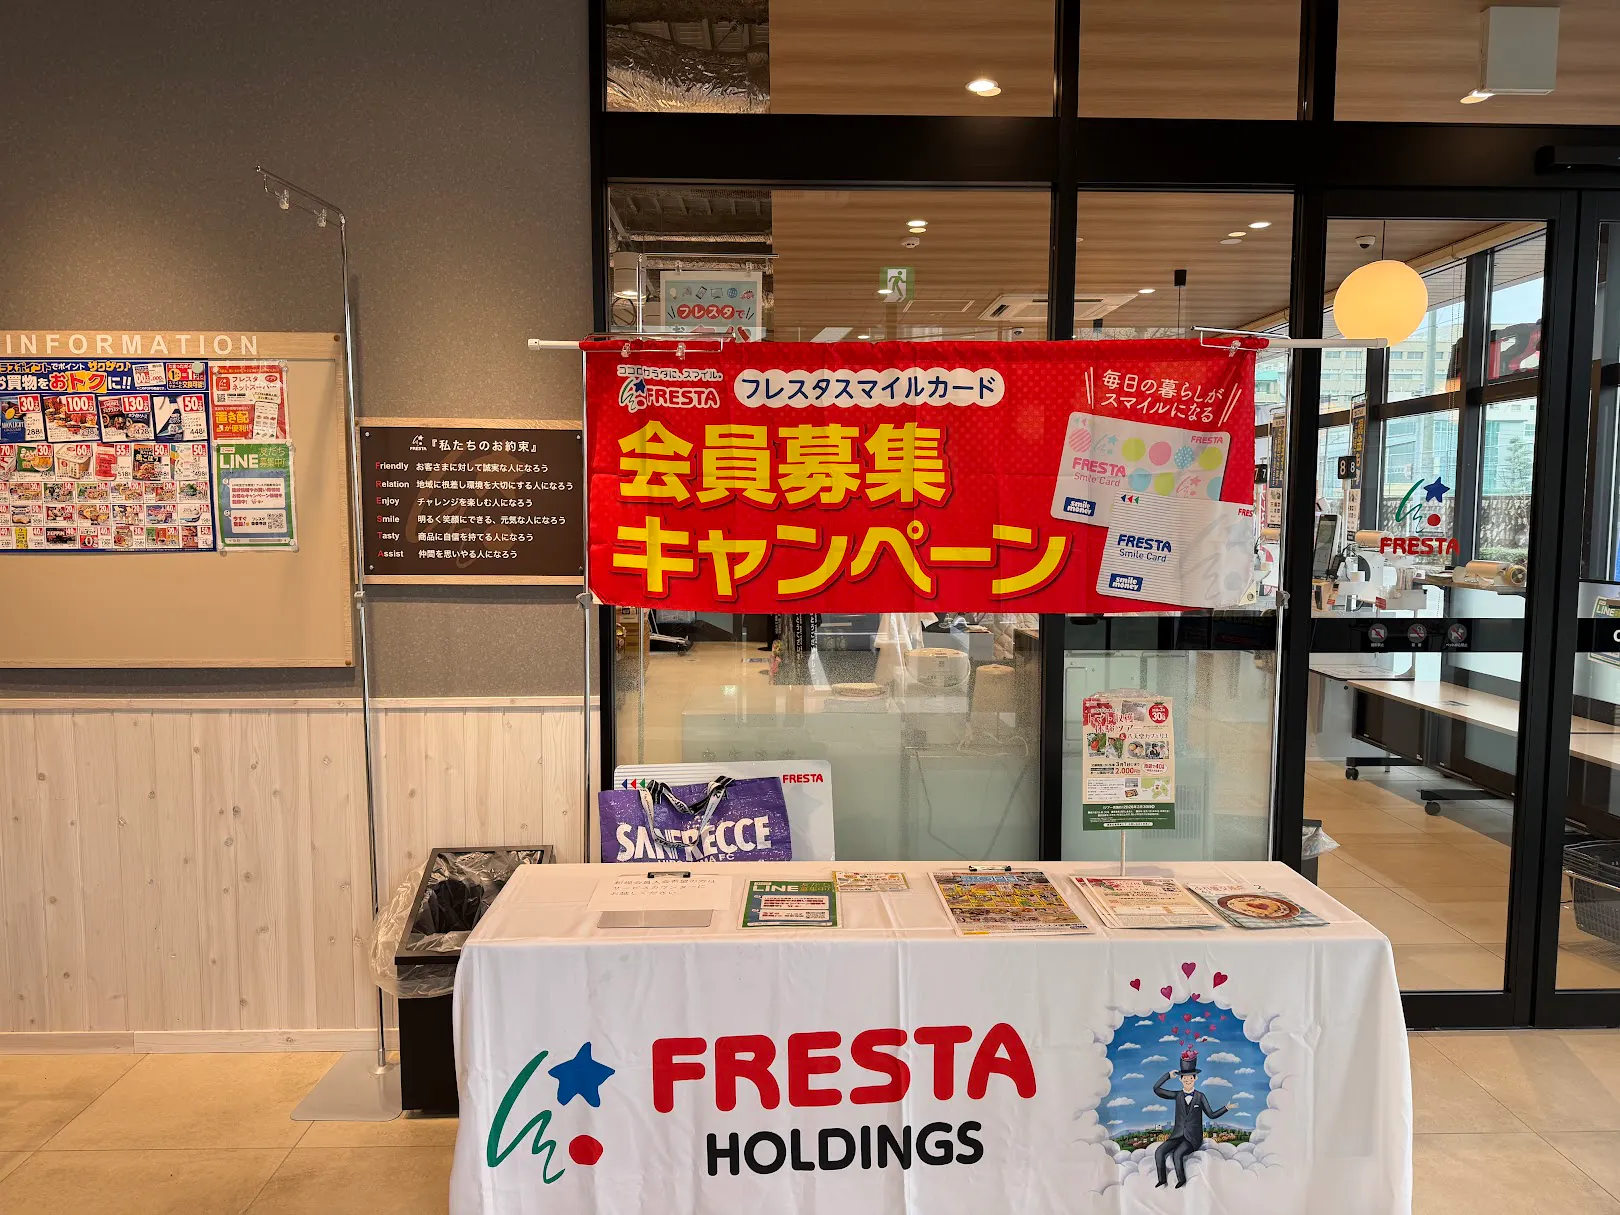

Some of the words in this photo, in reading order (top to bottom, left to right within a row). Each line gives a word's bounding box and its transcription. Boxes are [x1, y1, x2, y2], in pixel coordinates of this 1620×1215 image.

[677, 304, 745, 319] フレスタで
[6, 334, 258, 355] INFORMATION
[741, 375, 995, 401] フレスタスマイルカード
[1102, 369, 1224, 404] 毎日の暮らしが
[646, 387, 720, 408] FRESTA
[1101, 393, 1214, 423] スマイルになる
[215, 411, 249, 423] 置き配
[431, 439, 538, 453] 『私たちのお約束』
[1191, 435, 1223, 444] FRESTA
[220, 454, 258, 469] LINE
[375, 461, 409, 472] Friendly
[617, 420, 946, 504] 会員募集
[1072, 457, 1127, 478] FRESTA
[1340, 460, 1346, 475] 8
[1350, 461, 1355, 473] 8
[375, 480, 410, 489] Relation
[1099, 475, 1121, 487] Card
[376, 497, 400, 507] Enjoy
[1070, 499, 1091, 509] smile
[1066, 505, 1093, 516] money
[377, 515, 400, 523] Smile
[377, 532, 400, 541] Tasty
[1117, 534, 1172, 553] FRESTA
[1379, 536, 1460, 556] FRESTA
[377, 550, 404, 558] Assist
[612, 516, 1067, 596] キャンペーン
[1119, 548, 1144, 560] Smile
[1146, 551, 1168, 563] Card
[1112, 582, 1139, 592] money
[1115, 576, 1138, 586] smile
[1596, 604, 1616, 617] LINE
[782, 773, 824, 784] FRESTA
[650, 1022, 1037, 1113] FRESTA
[706, 1120, 985, 1178] HOLDINGS
